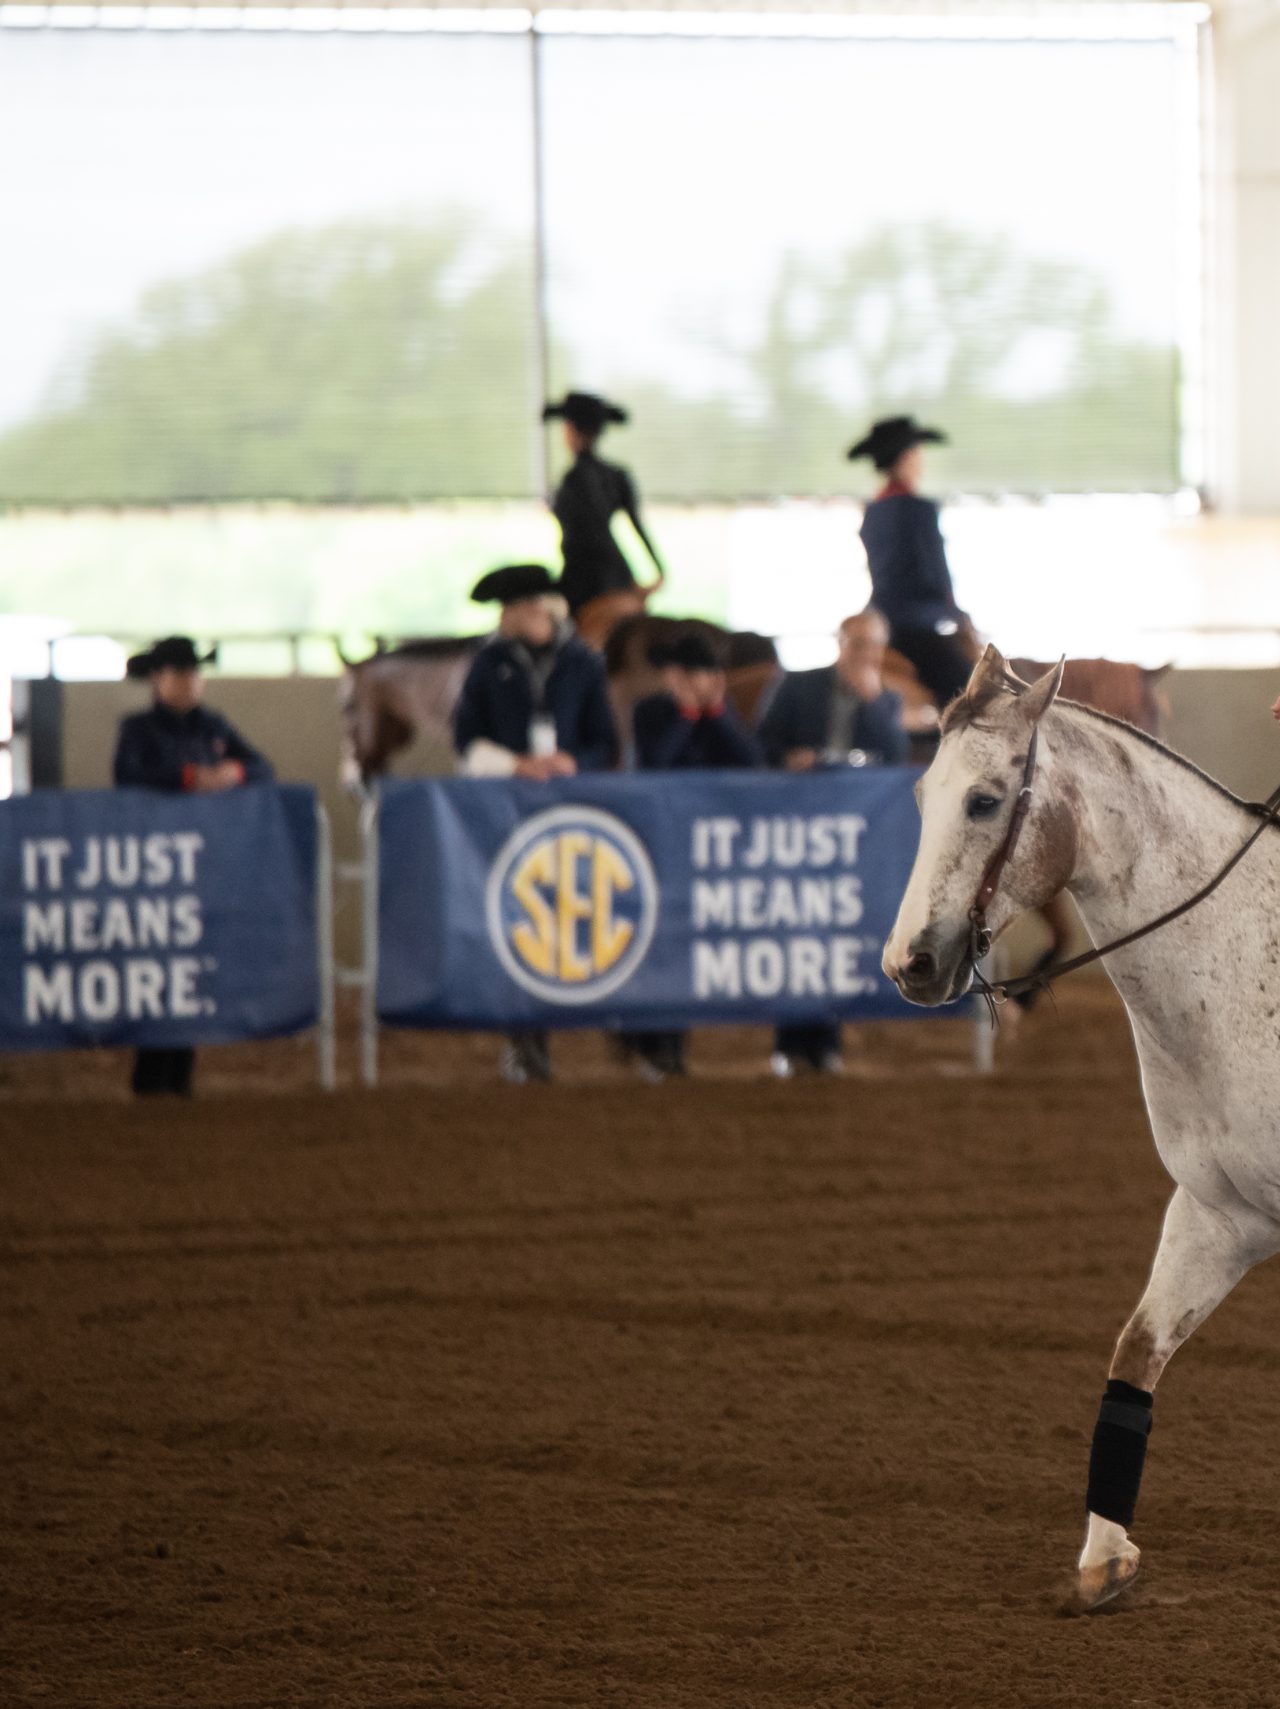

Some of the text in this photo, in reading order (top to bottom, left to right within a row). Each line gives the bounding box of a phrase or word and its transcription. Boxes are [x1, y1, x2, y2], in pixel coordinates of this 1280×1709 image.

[24, 831, 203, 890] IT JUST
[693, 814, 867, 869] IT JUST
[24, 895, 203, 953] MEANS
[512, 832, 635, 982] SEC
[693, 875, 863, 930] MEANS
